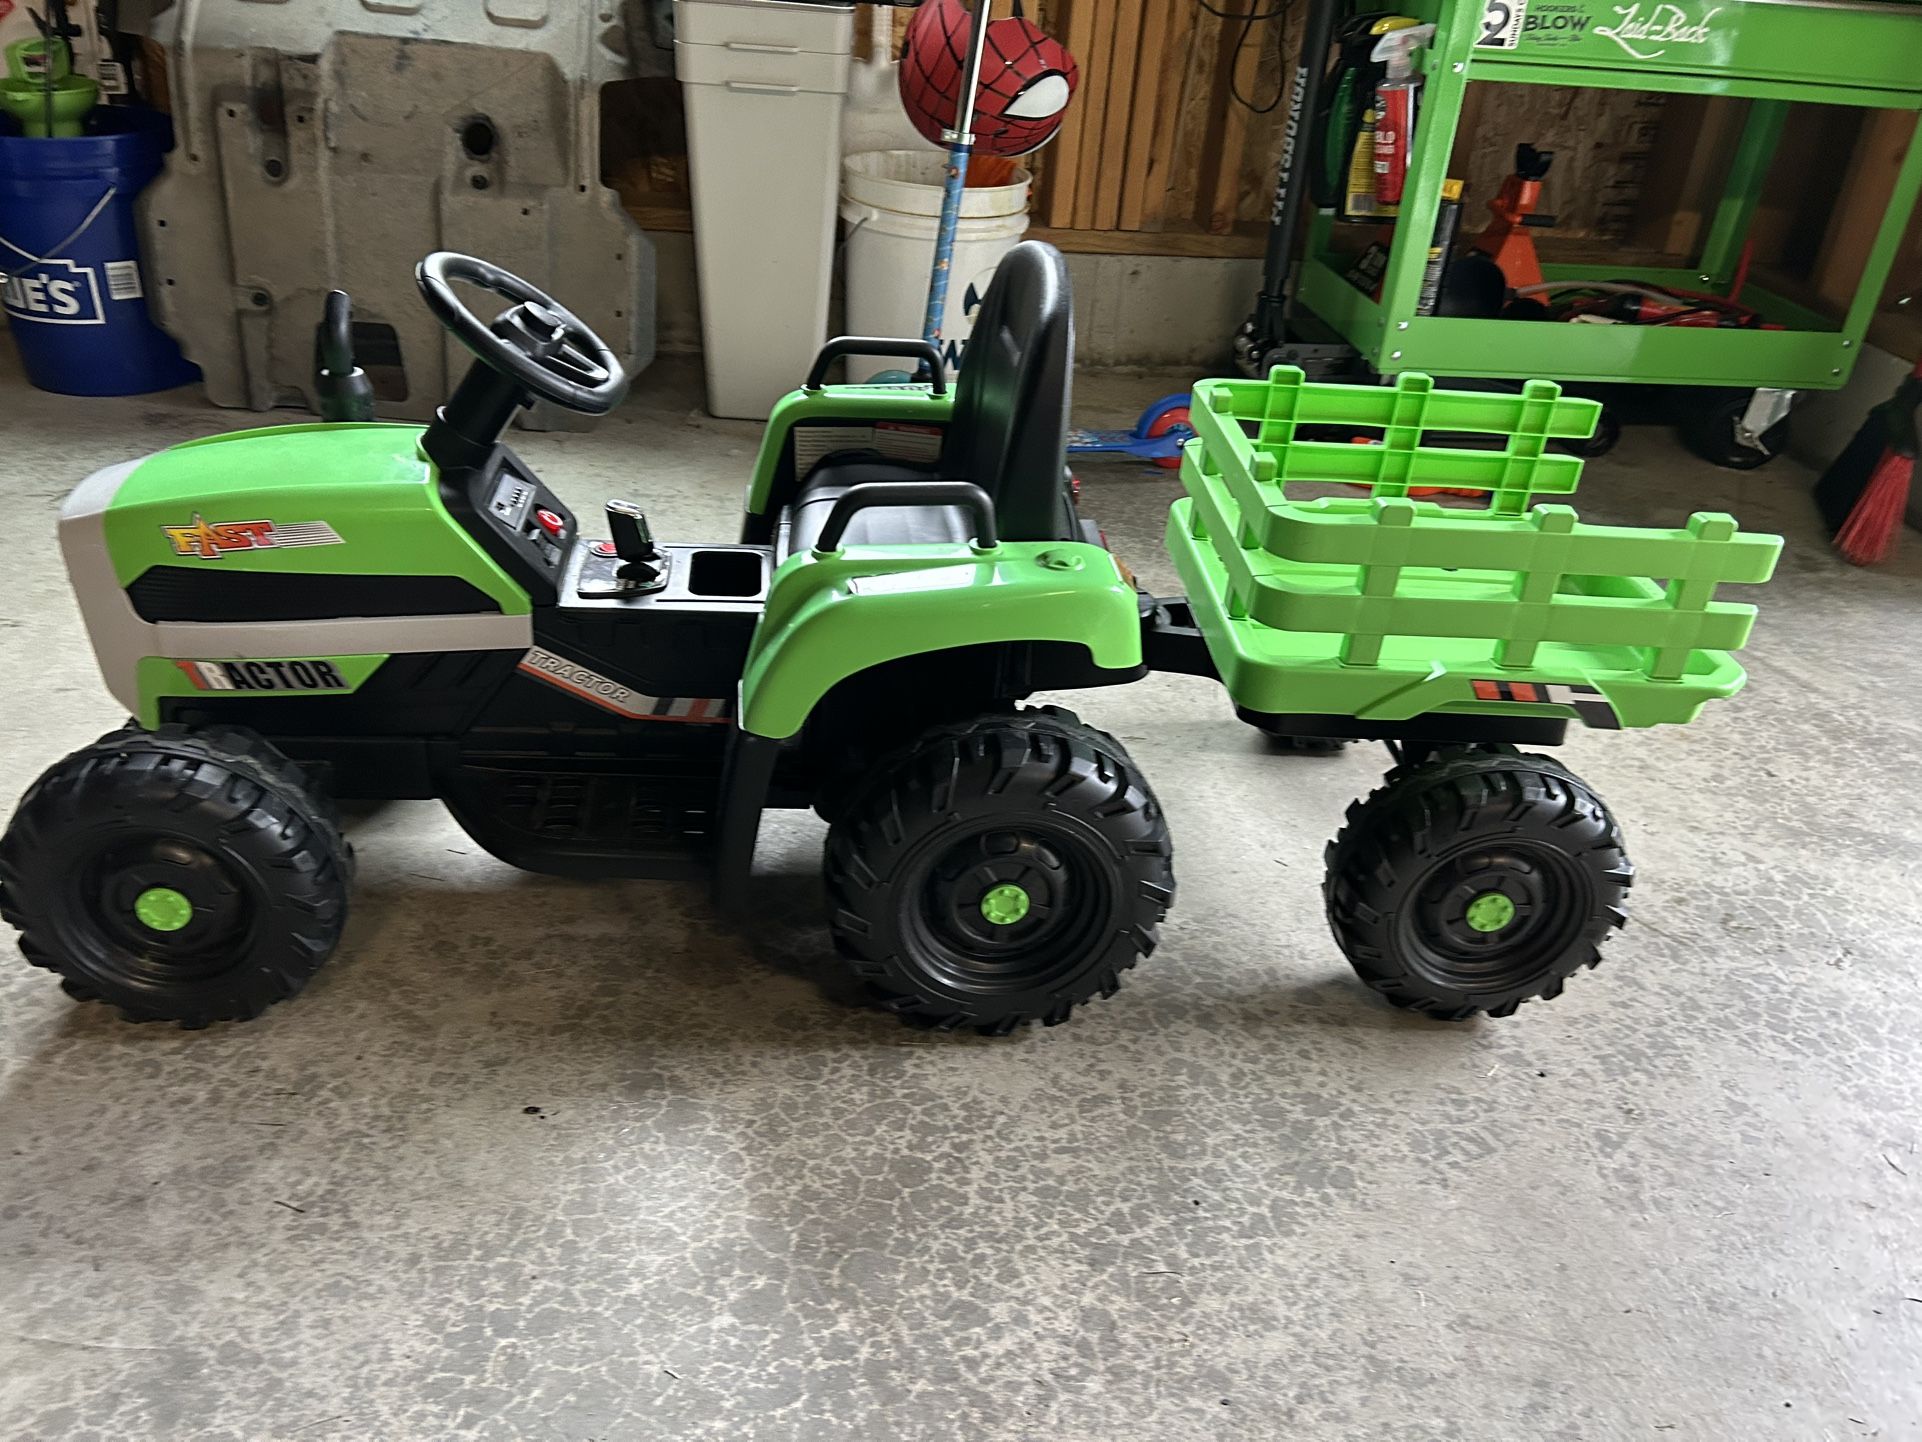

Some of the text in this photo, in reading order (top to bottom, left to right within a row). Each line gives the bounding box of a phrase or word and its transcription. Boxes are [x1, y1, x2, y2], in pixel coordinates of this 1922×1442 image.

[1524, 14, 1594, 32] BLOW
[162, 512, 280, 559] FAST
[176, 660, 348, 690] TRACTOR
[528, 650, 631, 703] TRACTOR
